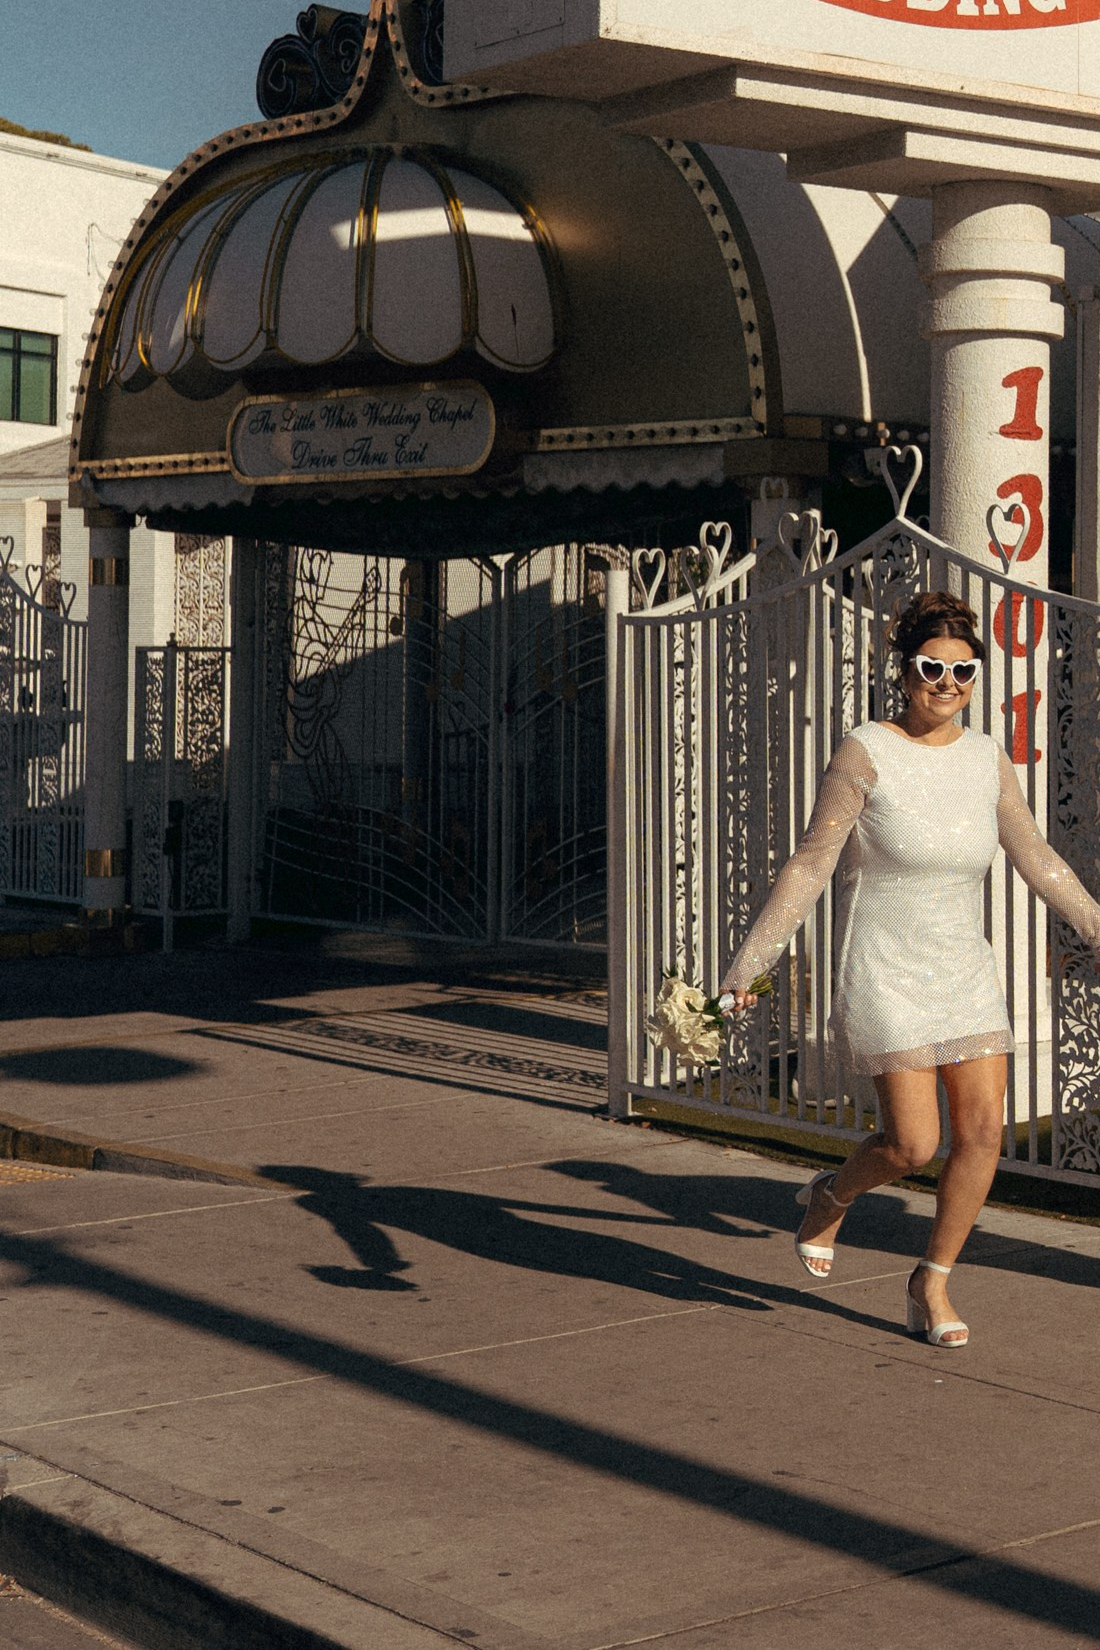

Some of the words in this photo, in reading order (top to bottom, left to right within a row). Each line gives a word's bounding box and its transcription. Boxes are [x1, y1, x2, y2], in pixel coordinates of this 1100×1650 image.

[249, 410, 275, 434] The
[280, 408, 315, 433] Little
[321, 405, 358, 431] White
[362, 401, 421, 434] Wedding
[426, 397, 478, 430] Chapel
[291, 440, 338, 469] Drive
[343, 437, 388, 467] Thru
[394, 434, 428, 464] Exit
[988, 366, 1043, 764] 1301
